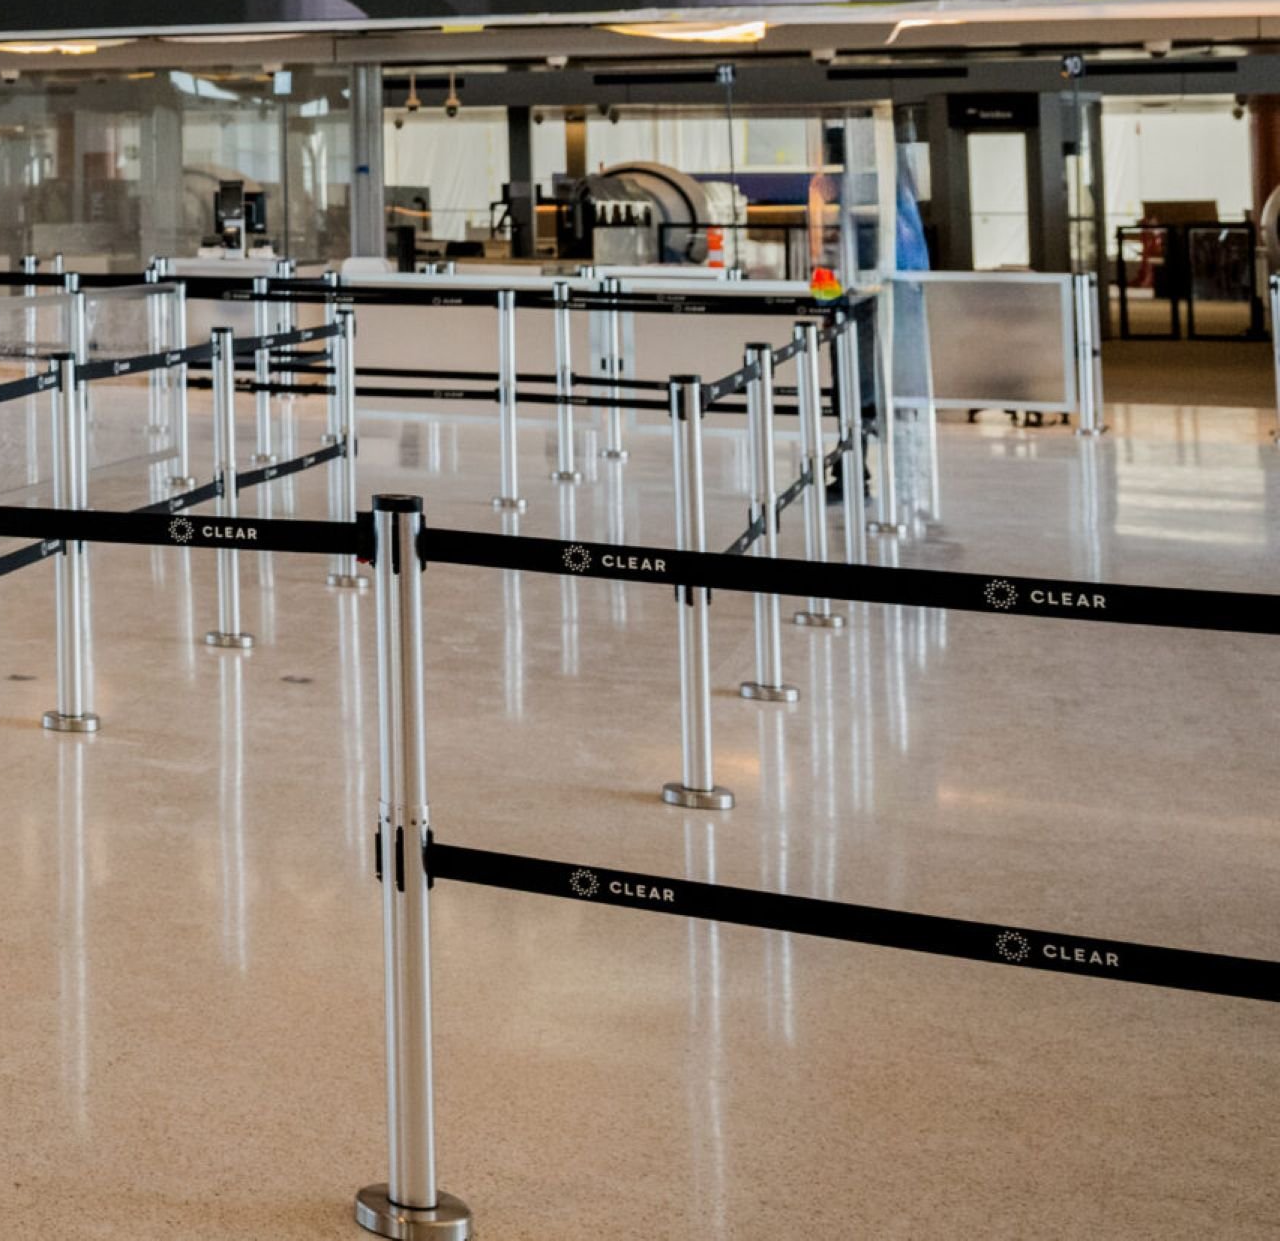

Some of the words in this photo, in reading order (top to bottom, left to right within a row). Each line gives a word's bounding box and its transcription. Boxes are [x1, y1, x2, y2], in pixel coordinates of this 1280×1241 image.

[718, 65, 733, 83] 11
[1064, 56, 1082, 74] 10
[202, 525, 258, 540] CLEAR
[601, 554, 666, 573] CLEAR
[1030, 590, 1106, 609] CLEAR
[609, 881, 674, 903] CLEAR
[1043, 944, 1119, 967] CLEAR
